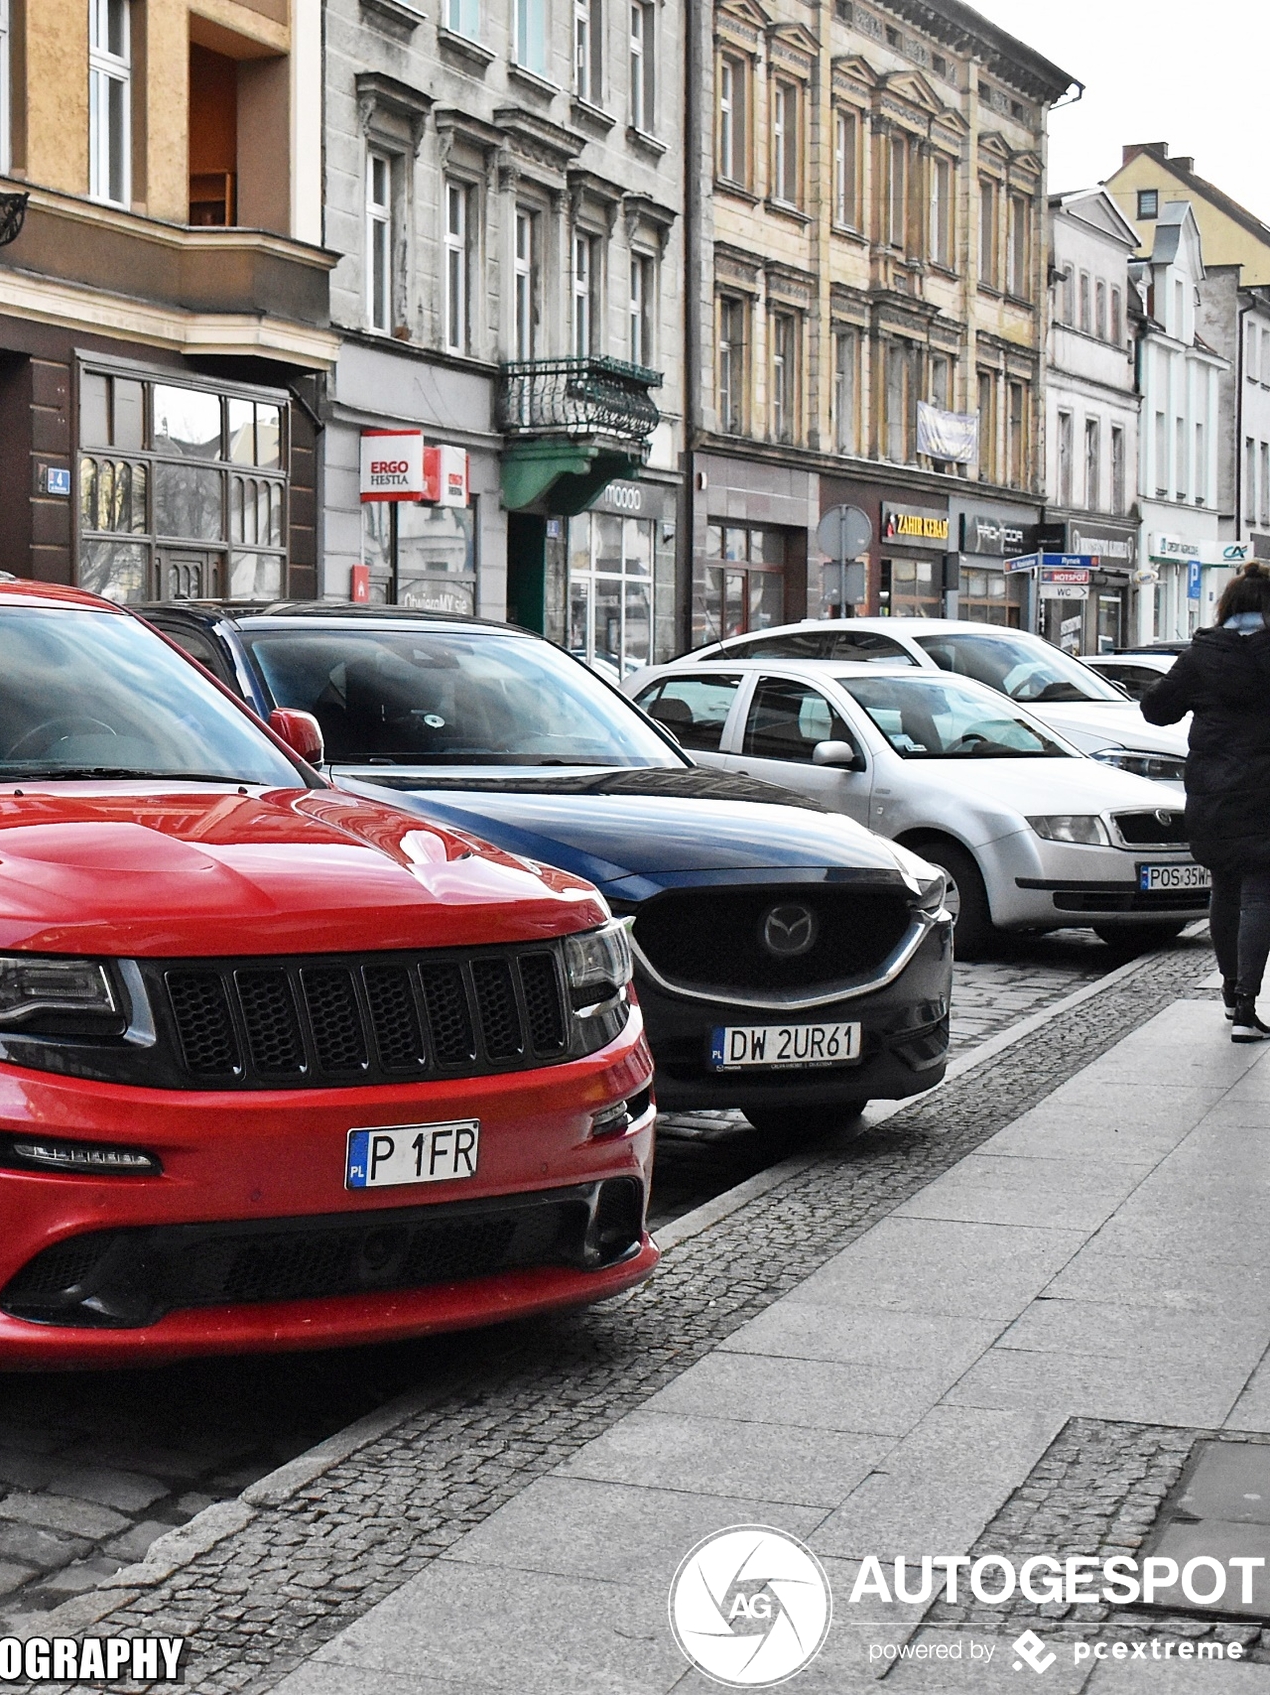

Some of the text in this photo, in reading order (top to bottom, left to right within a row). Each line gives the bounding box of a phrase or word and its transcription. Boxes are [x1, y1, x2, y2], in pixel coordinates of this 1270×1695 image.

[370, 460, 409, 475] ERGO
[56, 472, 63, 487] 4
[370, 474, 409, 486] HESTIA
[604, 484, 641, 510] moodo
[896, 513, 948, 540] ZAHIR KEBAB
[1061, 556, 1081, 566] Rynek
[1053, 573, 1086, 582] HOTSPOT
[1057, 588, 1072, 596] WC
[1150, 868, 1180, 887] POS
[712, 1025, 853, 1061] PL DW 2UR61
[350, 1127, 476, 1181] PL P 1FR
